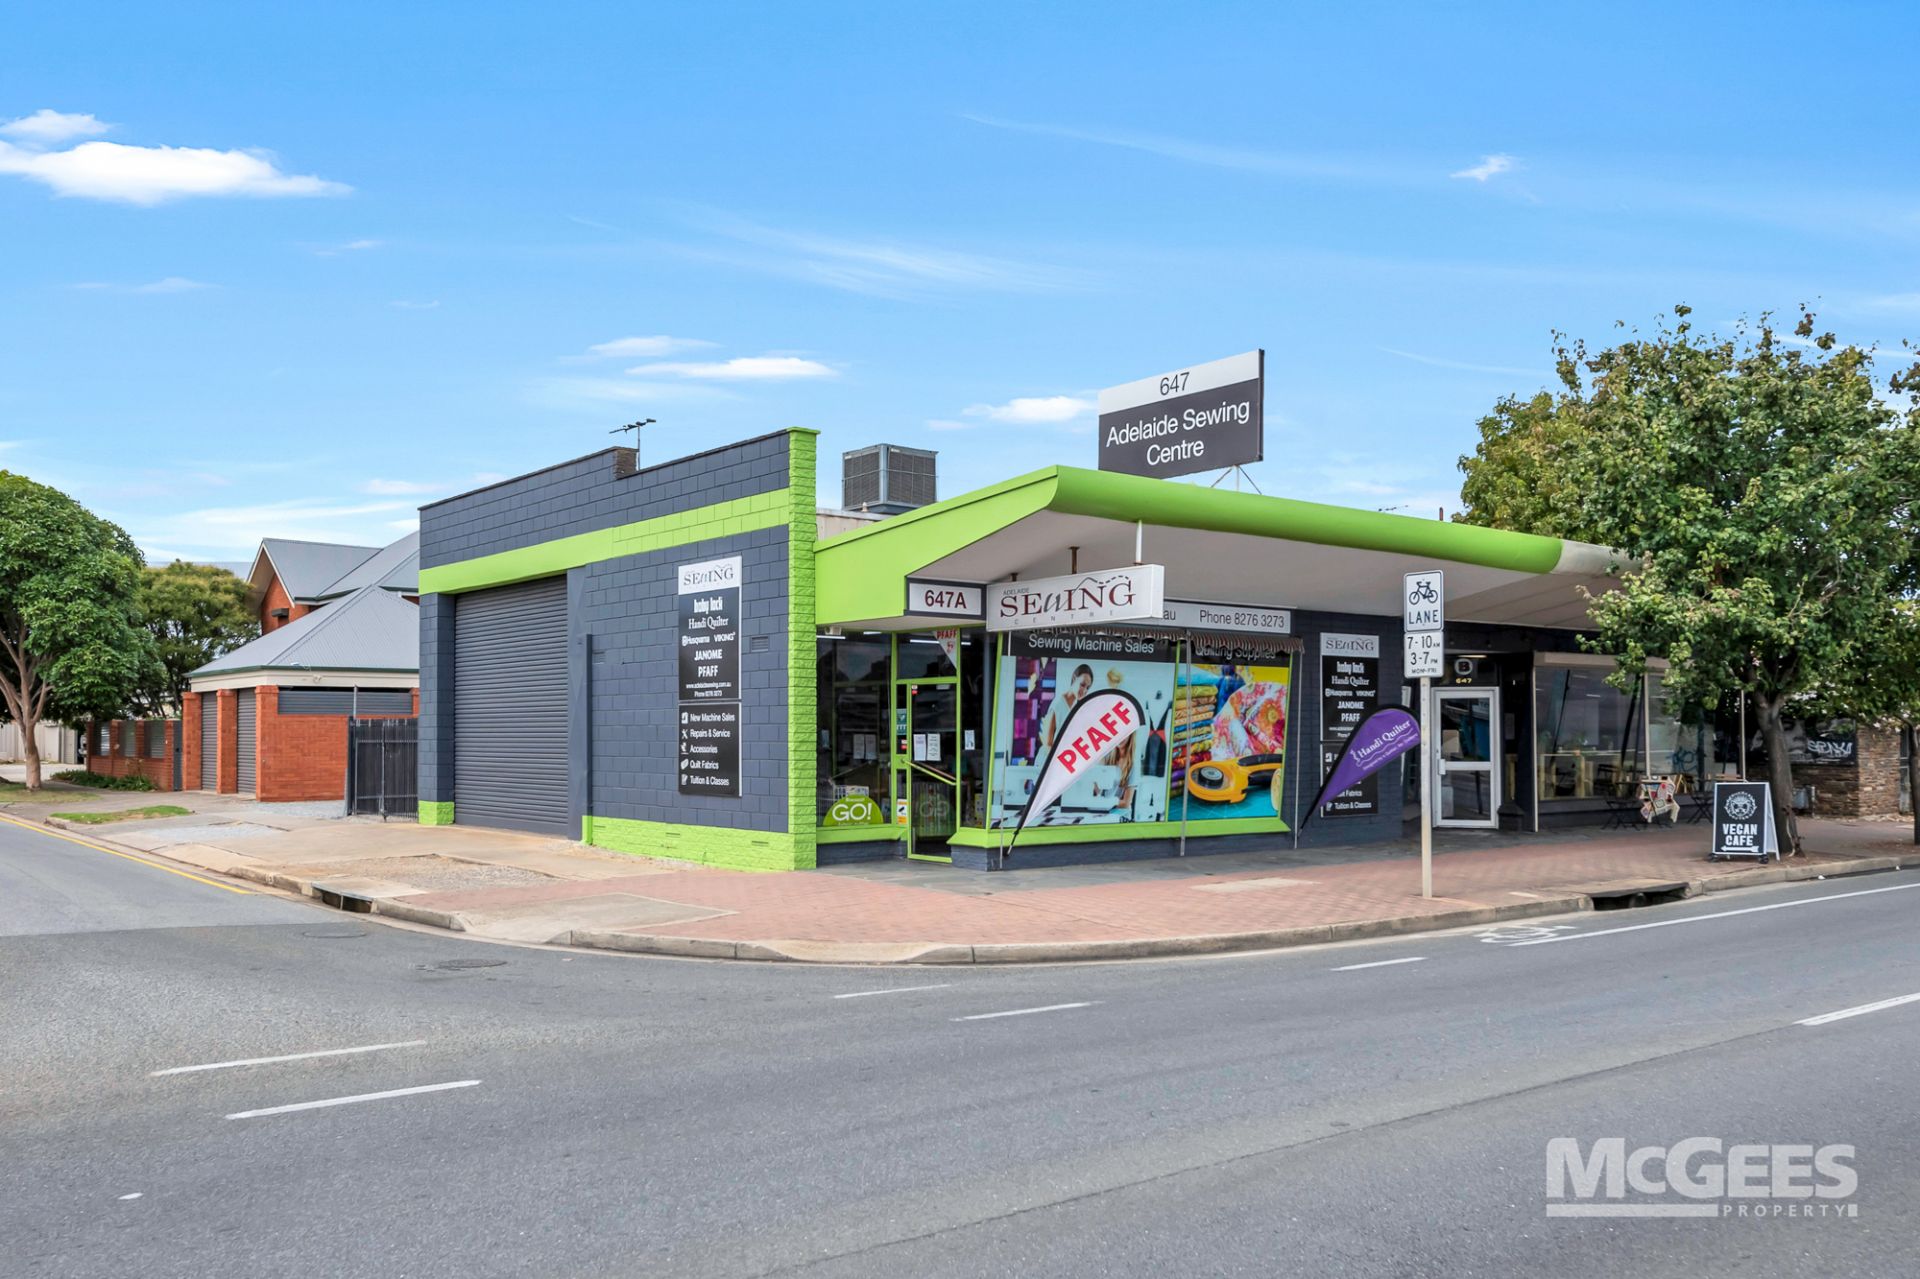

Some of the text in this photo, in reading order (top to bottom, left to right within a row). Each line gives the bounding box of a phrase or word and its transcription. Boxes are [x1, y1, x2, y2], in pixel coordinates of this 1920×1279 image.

[1160, 372, 1190, 396] 647
[1106, 401, 1250, 447] Adelaide Sewing
[1146, 440, 1205, 466] Centre
[924, 590, 967, 609] 647A
[1199, 609, 1232, 625] Phone
[1234, 612, 1259, 627] 8276
[1261, 614, 1285, 628] 3273
[1408, 609, 1439, 625] LANE
[1028, 633, 1154, 654] Sewing Machine Sales
[694, 649, 723, 661] JANOME
[698, 665, 719, 677] PFAFF
[1341, 712, 1360, 722] PFAFF
[1057, 701, 1131, 774] PFAFF
[1357, 735, 1384, 759] Handi
[1382, 720, 1411, 742] Quilter
[832, 803, 872, 821] GO!
[1722, 824, 1758, 835] VEGAN
[1725, 835, 1754, 846] CAFE
